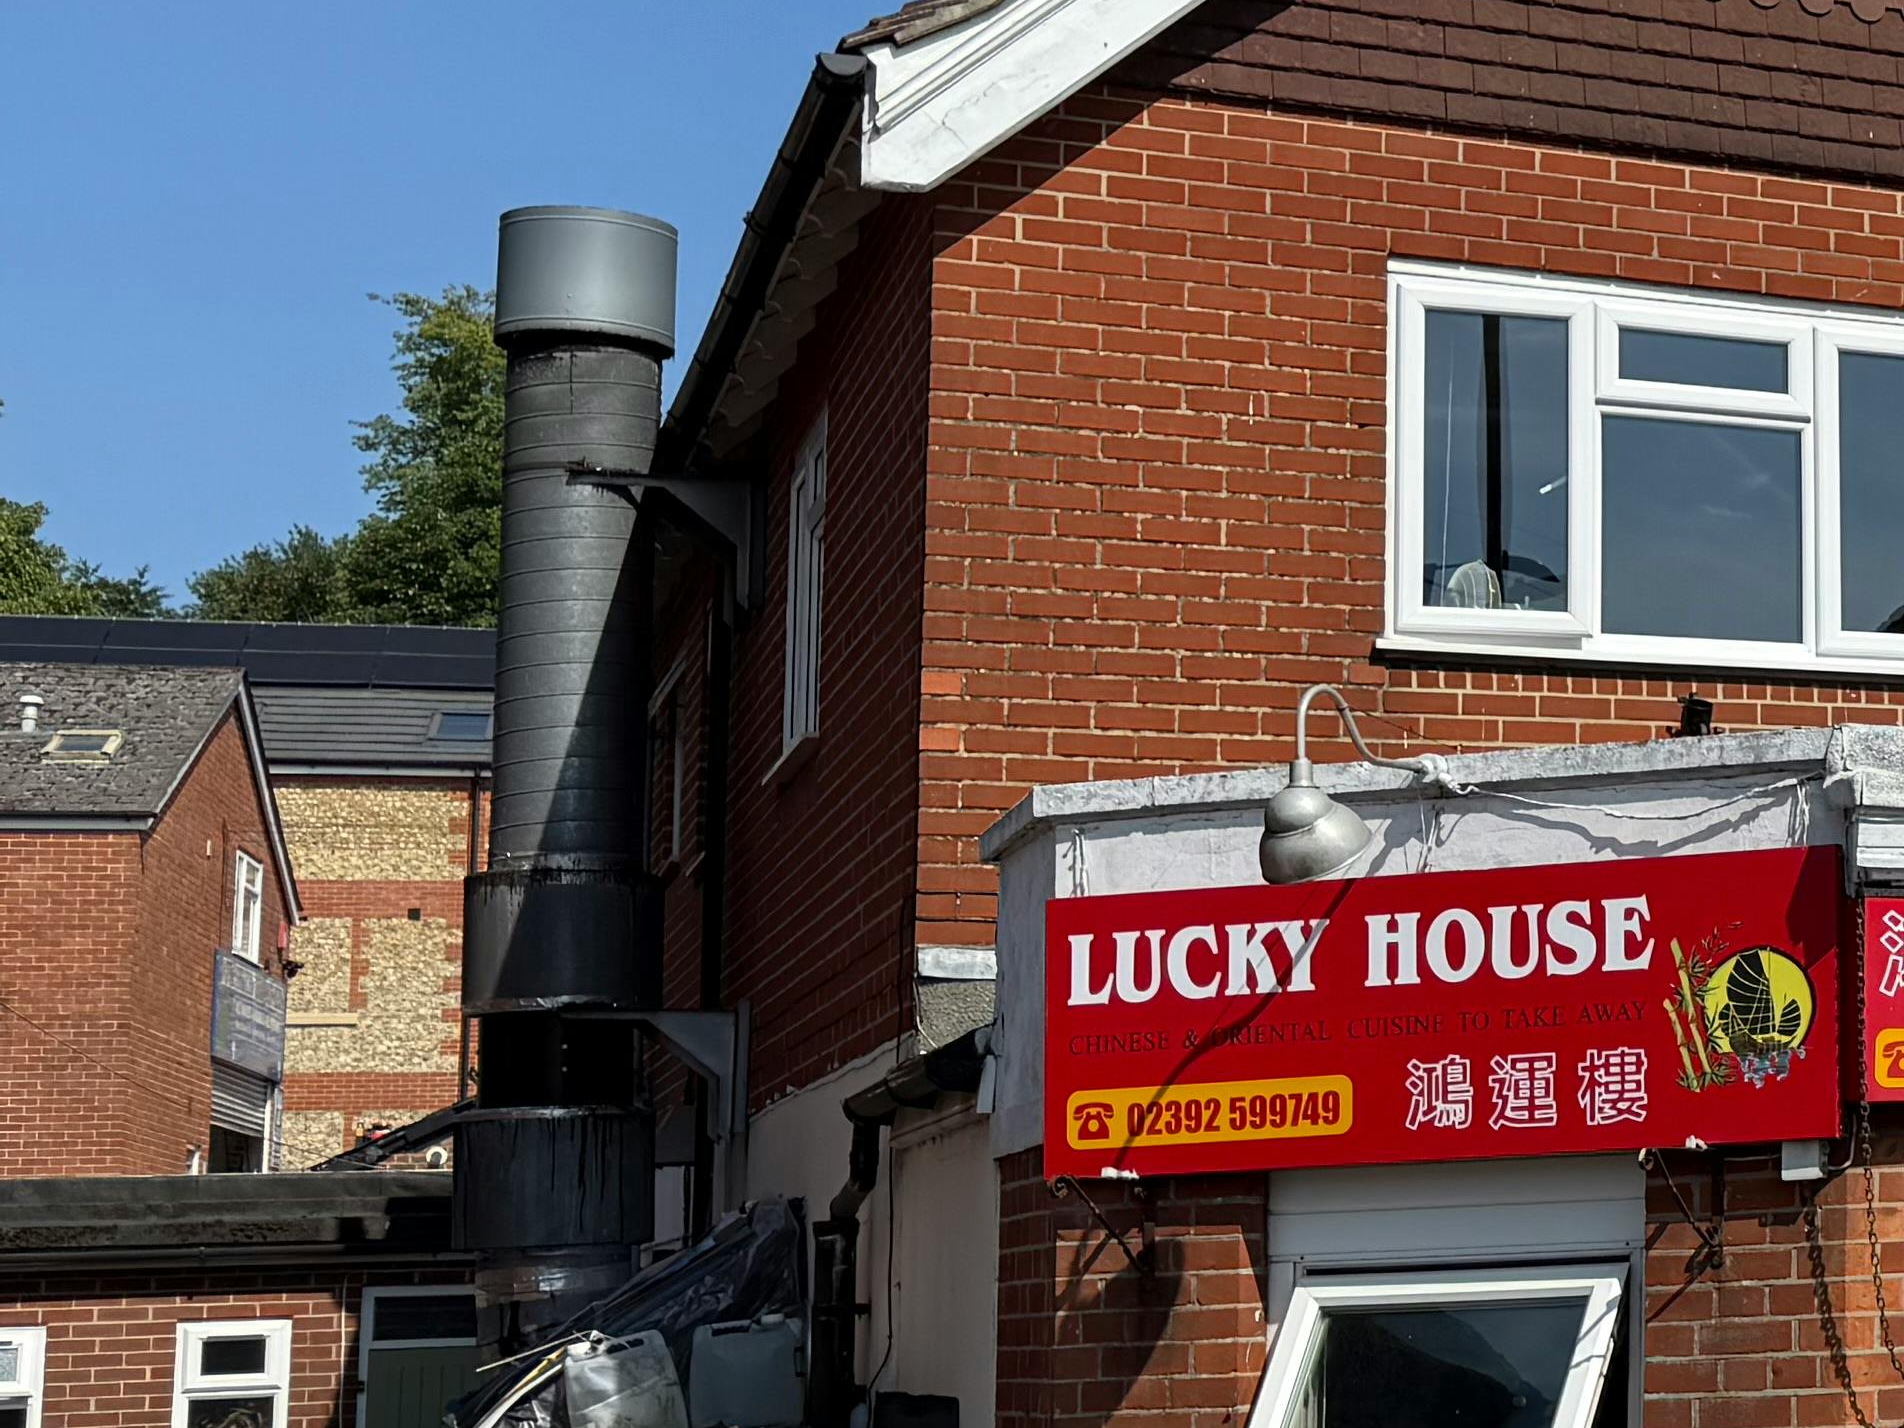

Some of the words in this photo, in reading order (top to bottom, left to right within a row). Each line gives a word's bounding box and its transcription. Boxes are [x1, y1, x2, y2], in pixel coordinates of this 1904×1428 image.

[1067, 918, 1329, 1006] LUCKY
[1363, 894, 1655, 987] HOUSE
[1069, 1030, 1169, 1056] CHINESE
[1183, 1029, 1200, 1049] &
[1212, 1021, 1332, 1049] ORIENTAL
[1347, 1013, 1442, 1039] CUISINE
[1457, 1011, 1490, 1033] TO
[1503, 1005, 1564, 1031] TAKE
[1577, 1000, 1648, 1024] AWAY
[1127, 1098, 1221, 1136] 02392
[1229, 1090, 1340, 1131] 599749
[1405, 1046, 1648, 1131] 鴻運樓
